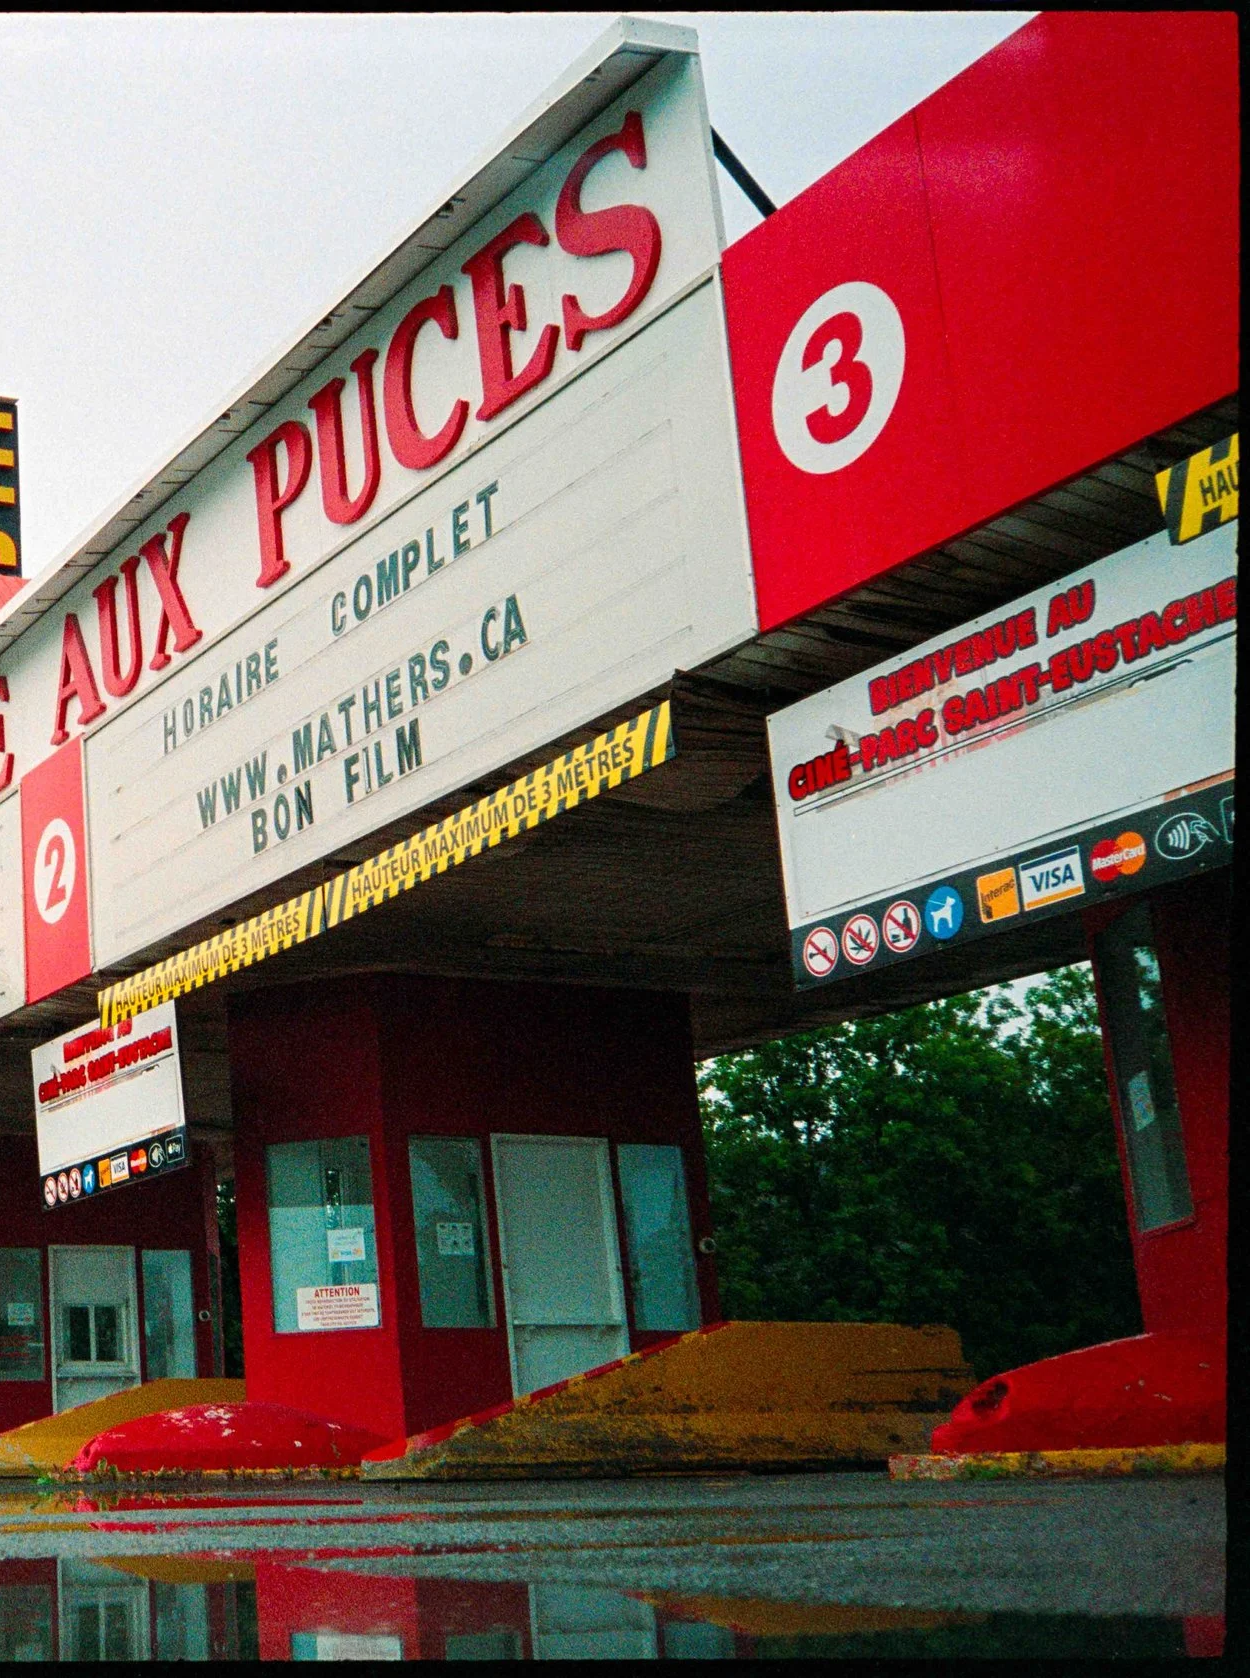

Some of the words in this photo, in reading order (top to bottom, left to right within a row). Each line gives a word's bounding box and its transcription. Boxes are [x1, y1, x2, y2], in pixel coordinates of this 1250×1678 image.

[50, 511, 203, 746] AUX
[246, 110, 663, 589] PUCES
[801, 311, 874, 445] 3
[162, 638, 280, 756] HORAIRE
[331, 479, 499, 637] COMPLET
[868, 606, 1038, 716] BIENVENUE
[1045, 578, 1096, 639] AU
[196, 593, 528, 829] WWW.MATHERS.CA
[788, 708, 938, 801] CINÉ-PARC
[942, 575, 1238, 736] SAINT-EUSTACHE
[251, 780, 315, 855] BON
[344, 717, 423, 804] FILM
[351, 852, 421, 902] HAUTEUR
[424, 805, 508, 866] MAXIMUM
[513, 793, 538, 817] DE
[542, 780, 552, 801] 3
[556, 737, 635, 792] MÈTRES
[43, 834, 67, 912] 2
[1028, 863, 1076, 893] VISA
[1090, 843, 1147, 872] MasterCard
[115, 976, 163, 1012] HAUTEUR
[164, 950, 220, 991] MAXIMUM
[222, 944, 239, 964] DE
[242, 937, 248, 955] 3
[251, 911, 301, 951] MÈTRES
[113, 1161, 126, 1175] VISA
[314, 1286, 360, 1298] ATTENTION
